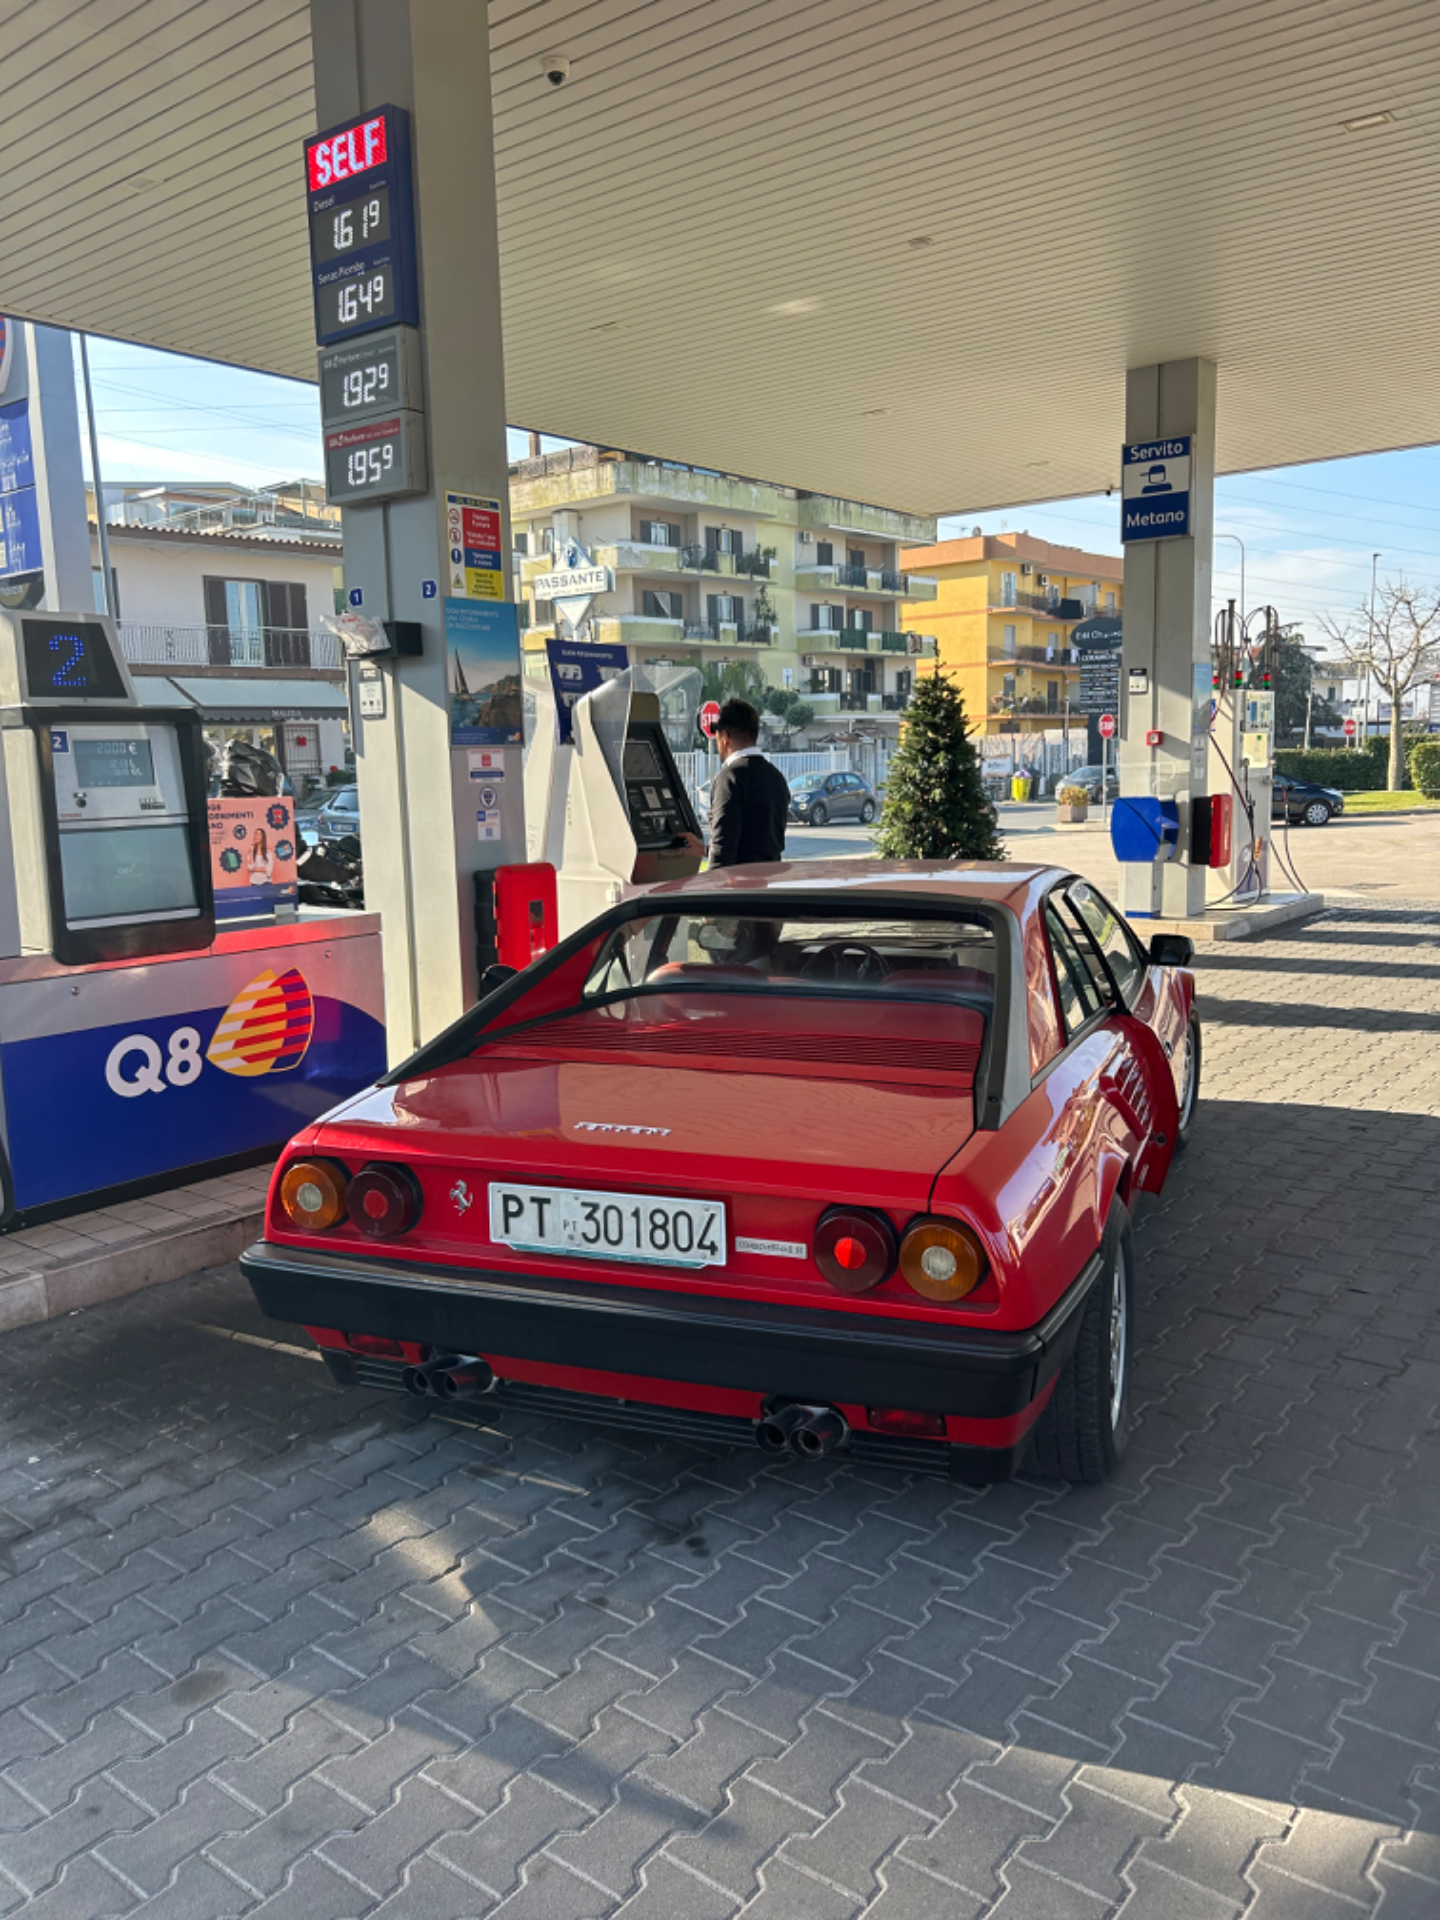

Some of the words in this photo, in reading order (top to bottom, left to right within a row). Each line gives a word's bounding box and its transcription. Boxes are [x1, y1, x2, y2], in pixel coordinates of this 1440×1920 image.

[315, 120, 380, 186] SELF
[1130, 441, 1184, 461] Servito
[1126, 510, 1186, 528] Metano
[426, 585, 432, 595] 2
[535, 571, 605, 590] PASSANTE
[354, 592, 360, 603] 1
[49, 634, 86, 686] 2
[53, 736, 62, 749] 2
[105, 1026, 203, 1098] Q8
[502, 1194, 552, 1239] PT
[580, 1201, 718, 1256] 301804
